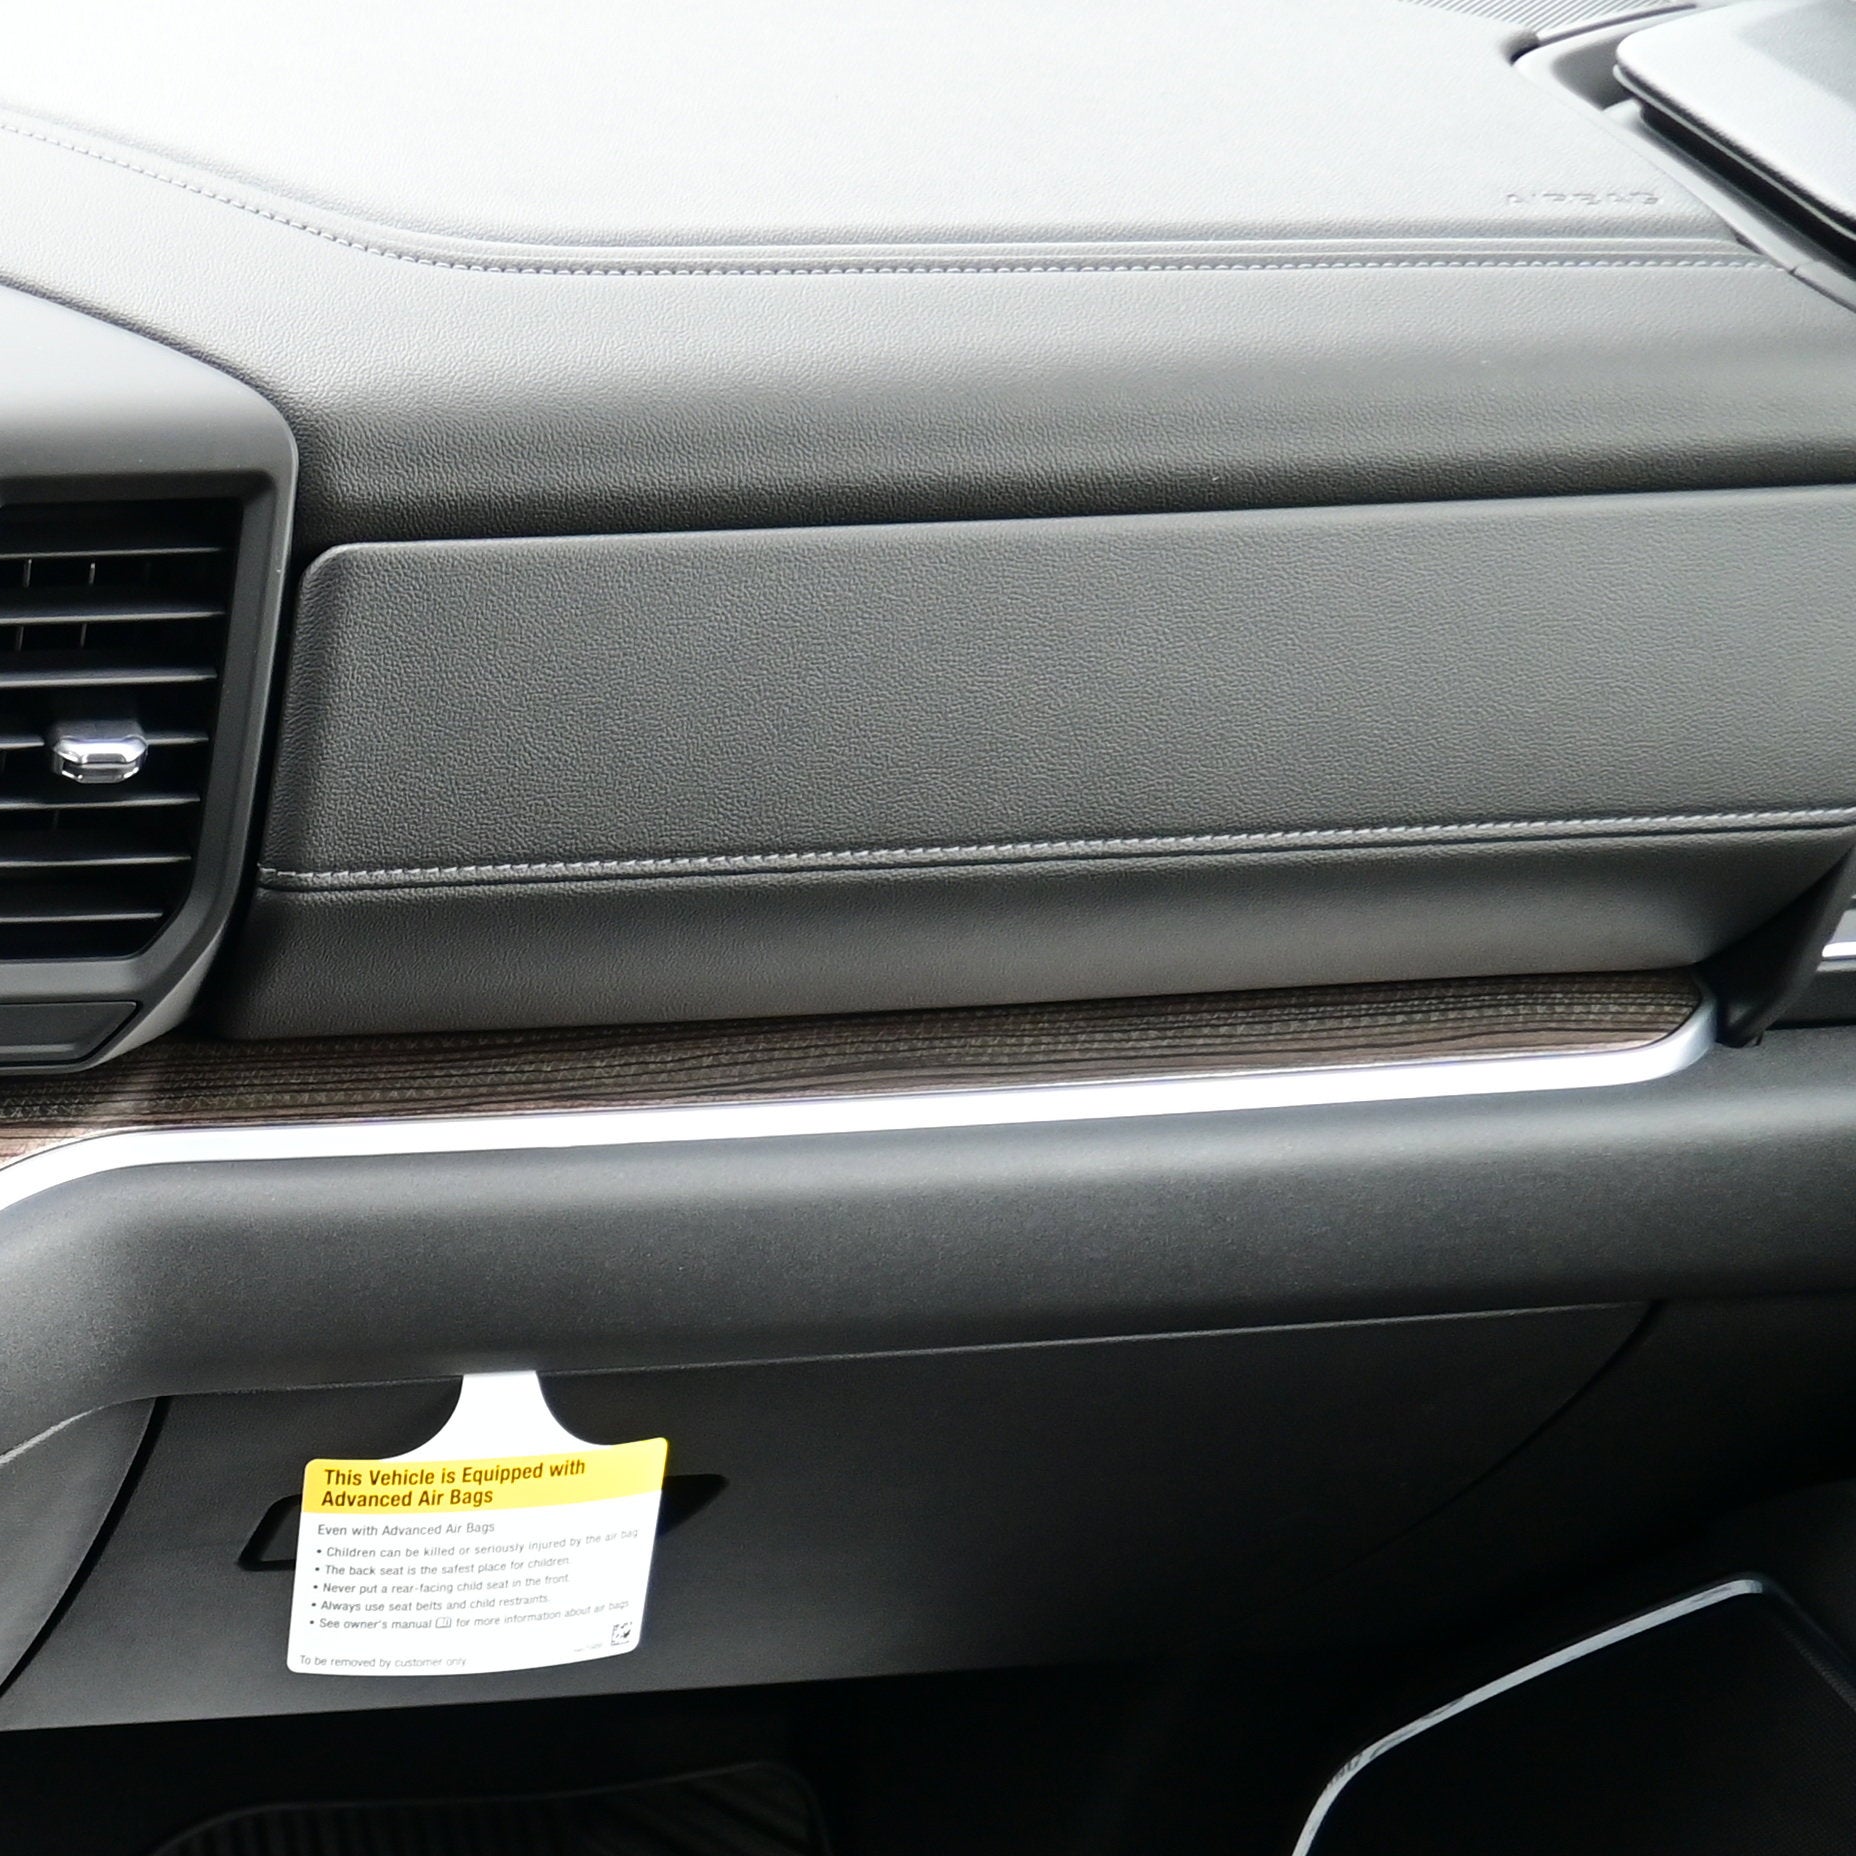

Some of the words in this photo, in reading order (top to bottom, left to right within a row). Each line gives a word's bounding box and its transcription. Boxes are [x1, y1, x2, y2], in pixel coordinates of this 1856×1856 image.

[324, 1468, 362, 1486] This
[369, 1468, 435, 1486] Vehicle
[441, 1467, 456, 1485] is
[461, 1462, 544, 1486] Equipped
[549, 1458, 586, 1477] with
[320, 1490, 413, 1507] Advanced
[417, 1489, 444, 1506] Air
[449, 1488, 494, 1508] Bags
[317, 1524, 348, 1536] Even
[351, 1524, 379, 1536] with
[382, 1524, 442, 1536] Advanced
[445, 1523, 463, 1535] Air
[466, 1522, 495, 1536] Bags
[326, 1546, 376, 1558] Children
[380, 1548, 402, 1558] can
[405, 1547, 420, 1558] be
[423, 1546, 455, 1557] killed
[459, 1547, 471, 1556] or
[474, 1543, 525, 1556] seriously
[528, 1539, 566, 1552] injured
[569, 1537, 582, 1549] by
[585, 1534, 602, 1545] the
[324, 1564, 346, 1576] The
[349, 1564, 376, 1576] back
[380, 1565, 403, 1576] seat
[407, 1565, 417, 1575] is
[420, 1564, 438, 1575] the
[441, 1563, 475, 1575] safest
[477, 1561, 506, 1574] place
[510, 1559, 524, 1570] for
[322, 1583, 356, 1594] Never
[359, 1583, 378, 1595] put
[391, 1582, 454, 1595] rear-facing
[456, 1581, 484, 1592] child
[486, 1579, 509, 1590] seat
[512, 1577, 522, 1587] in
[525, 1576, 541, 1586] the
[320, 1600, 361, 1613] Always
[365, 1602, 385, 1612] use
[388, 1601, 412, 1612] seat
[416, 1600, 443, 1611] belts
[446, 1599, 467, 1610] and
[470, 1598, 496, 1609] child
[319, 1617, 340, 1629] See
[391, 1618, 432, 1629] manual
[455, 1617, 470, 1627] for
[474, 1616, 501, 1626] more
[504, 1611, 561, 1624] information
[564, 1606, 591, 1618] about
[300, 1654, 311, 1665] To
[314, 1656, 327, 1666] be
[330, 1657, 376, 1668] removed
[379, 1657, 391, 1670] by
[394, 1657, 443, 1668] customer
